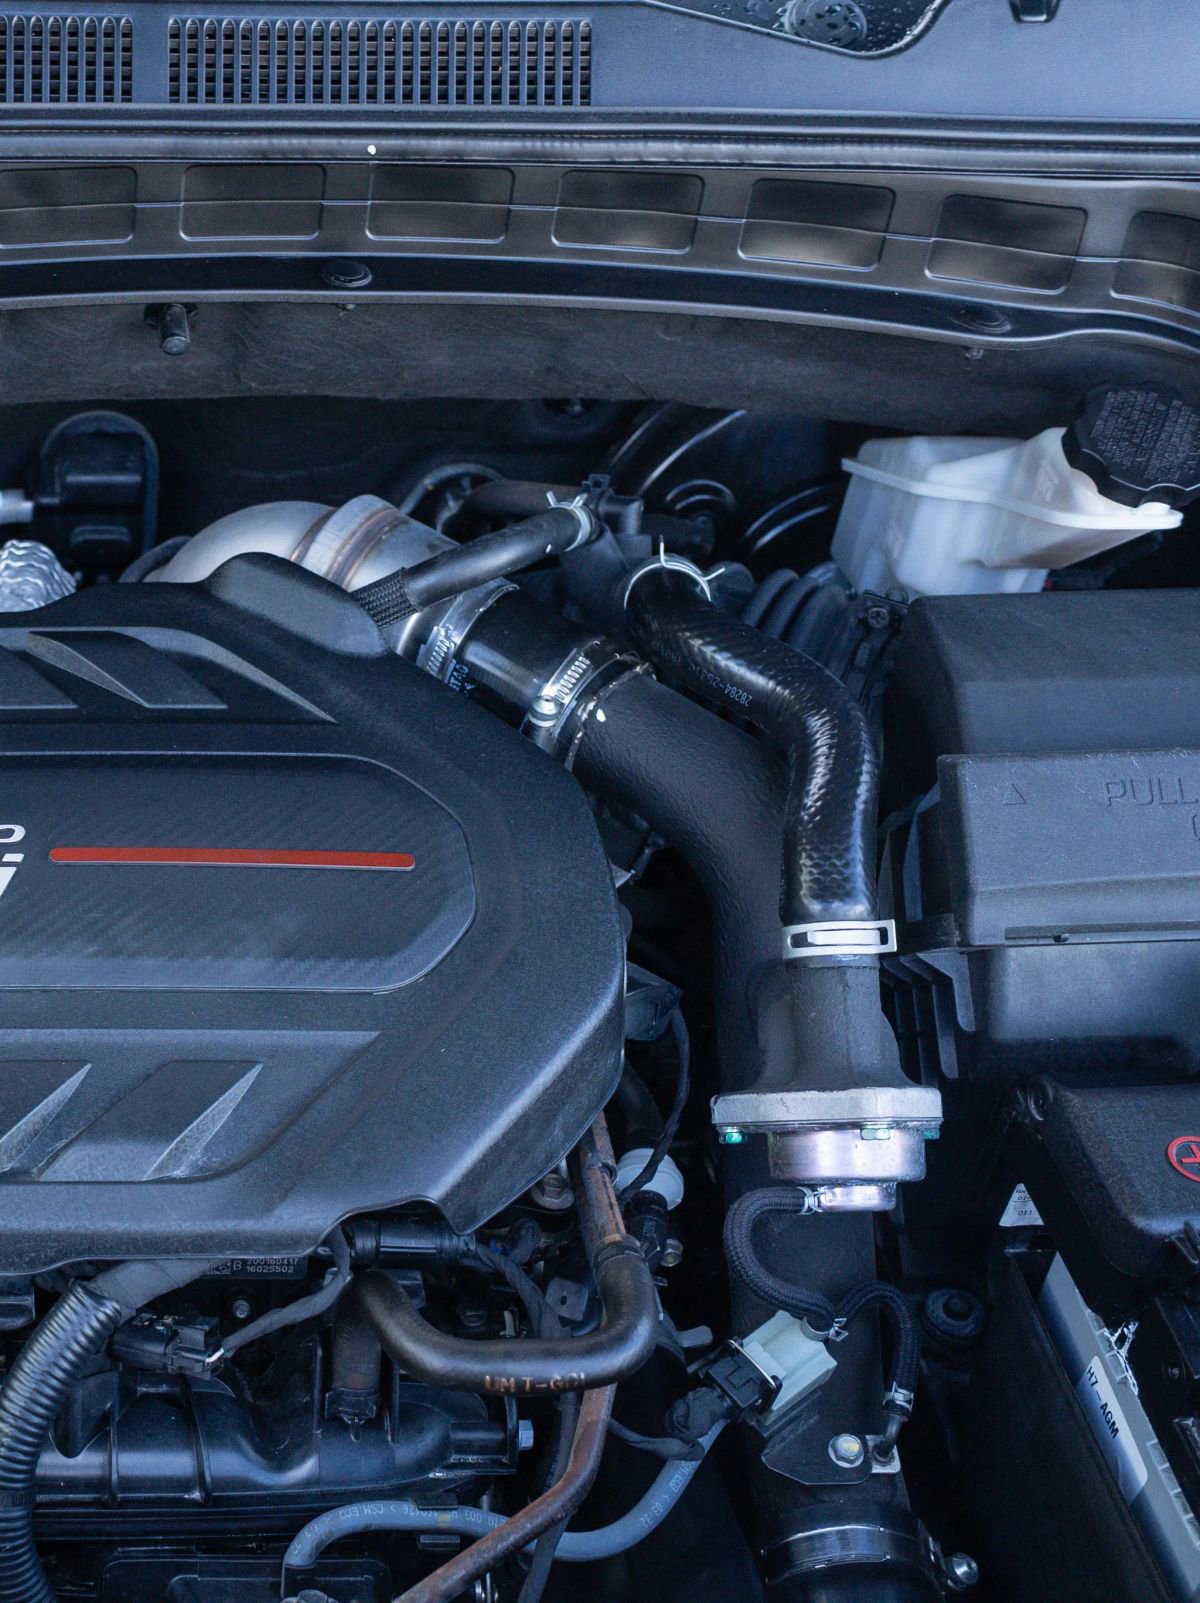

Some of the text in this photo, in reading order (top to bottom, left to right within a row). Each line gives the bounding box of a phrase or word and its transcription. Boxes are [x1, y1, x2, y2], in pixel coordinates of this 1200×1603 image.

[1103, 777, 1199, 808] PULL
[233, 1260, 242, 1270] B
[1087, 1366, 1099, 1388] H7
[1100, 1402, 1120, 1439] AGM
